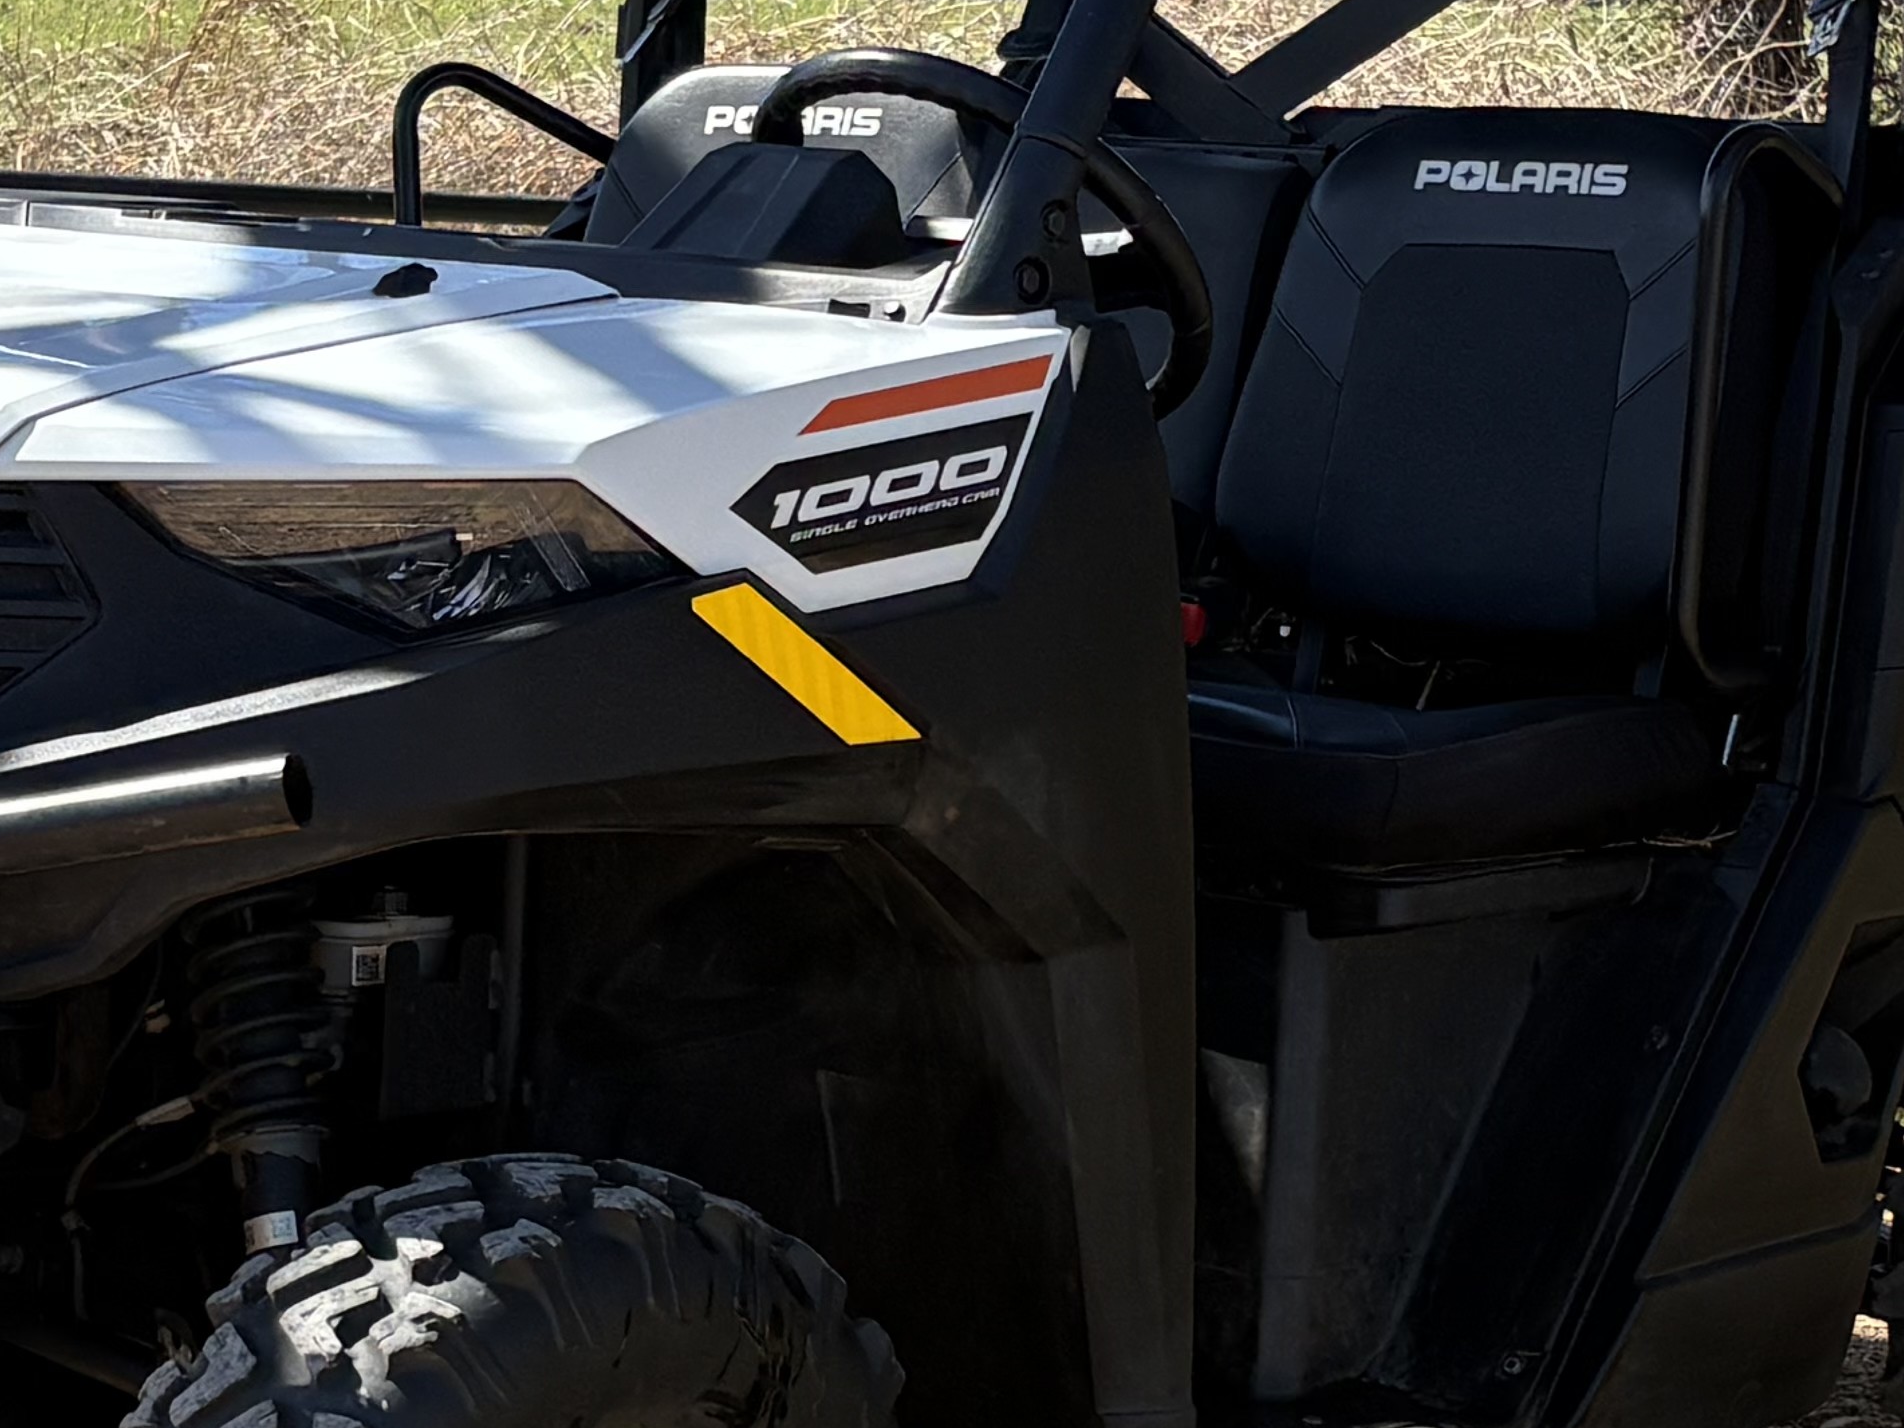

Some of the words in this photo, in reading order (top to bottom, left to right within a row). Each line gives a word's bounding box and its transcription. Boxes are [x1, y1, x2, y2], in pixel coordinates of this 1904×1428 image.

[704, 104, 883, 137] PORIS
[1413, 159, 1629, 196] POLARIS
[770, 445, 1008, 530] 1000
[790, 518, 858, 543] SINGLE
[864, 496, 959, 526] OVERHEAD
[961, 487, 1000, 505] CAM
